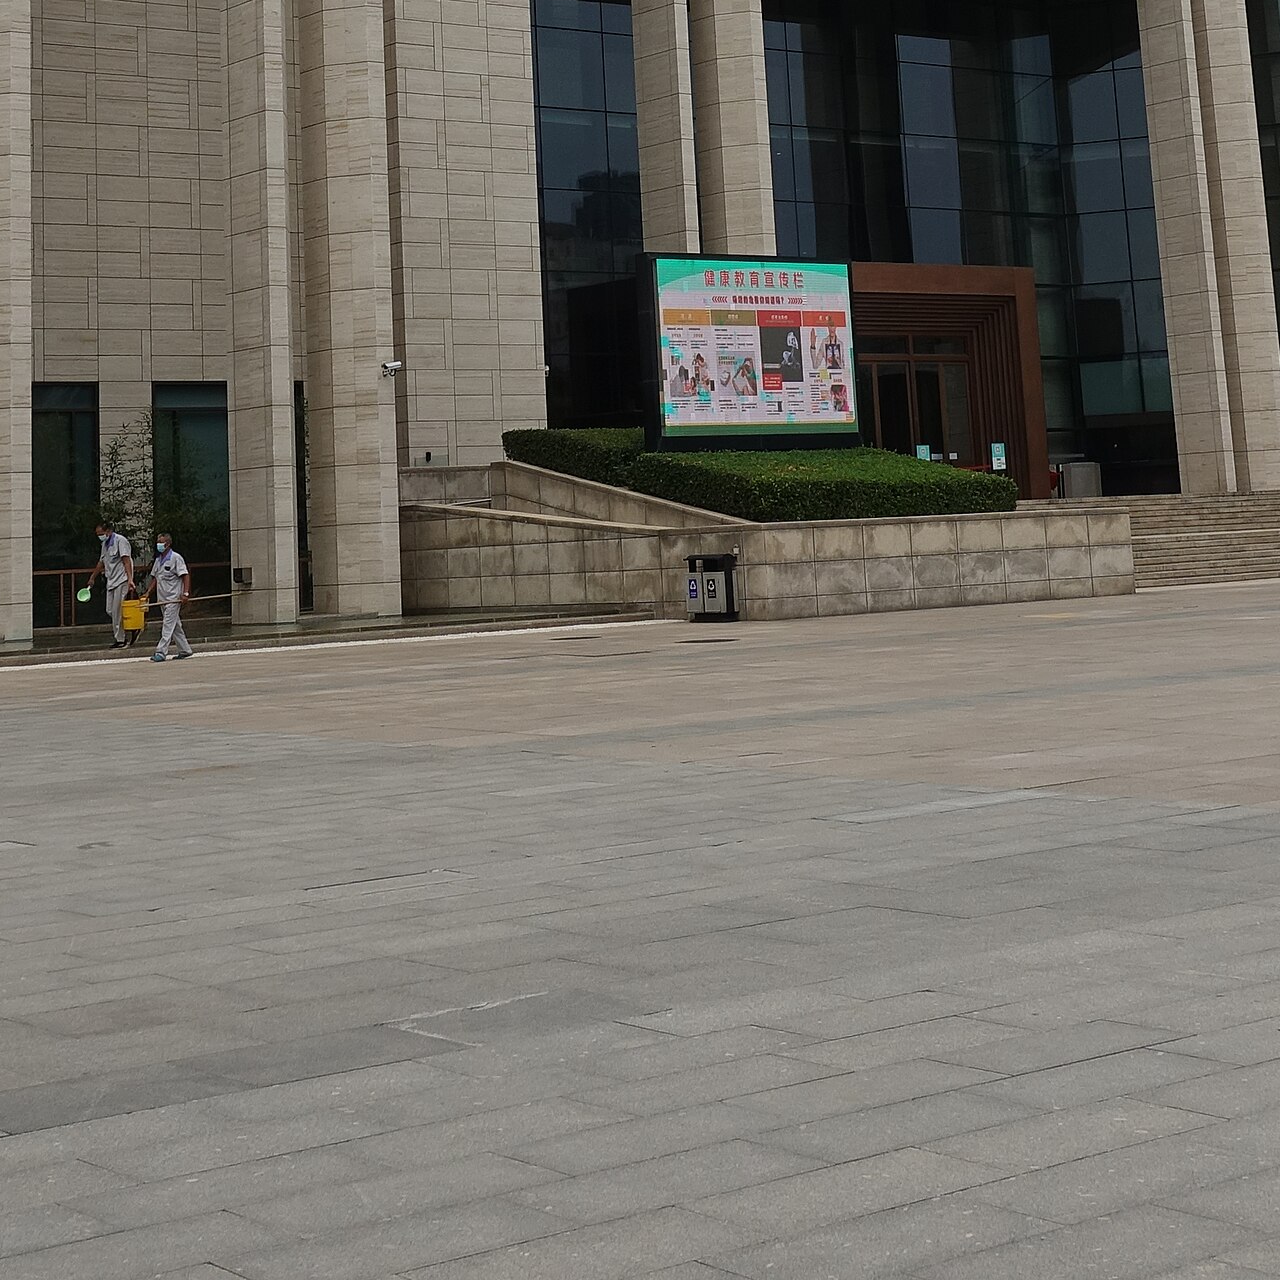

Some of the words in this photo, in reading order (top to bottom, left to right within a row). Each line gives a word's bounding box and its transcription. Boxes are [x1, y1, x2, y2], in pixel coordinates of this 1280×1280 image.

[704, 270, 805, 289] 健康教育宣传栏
